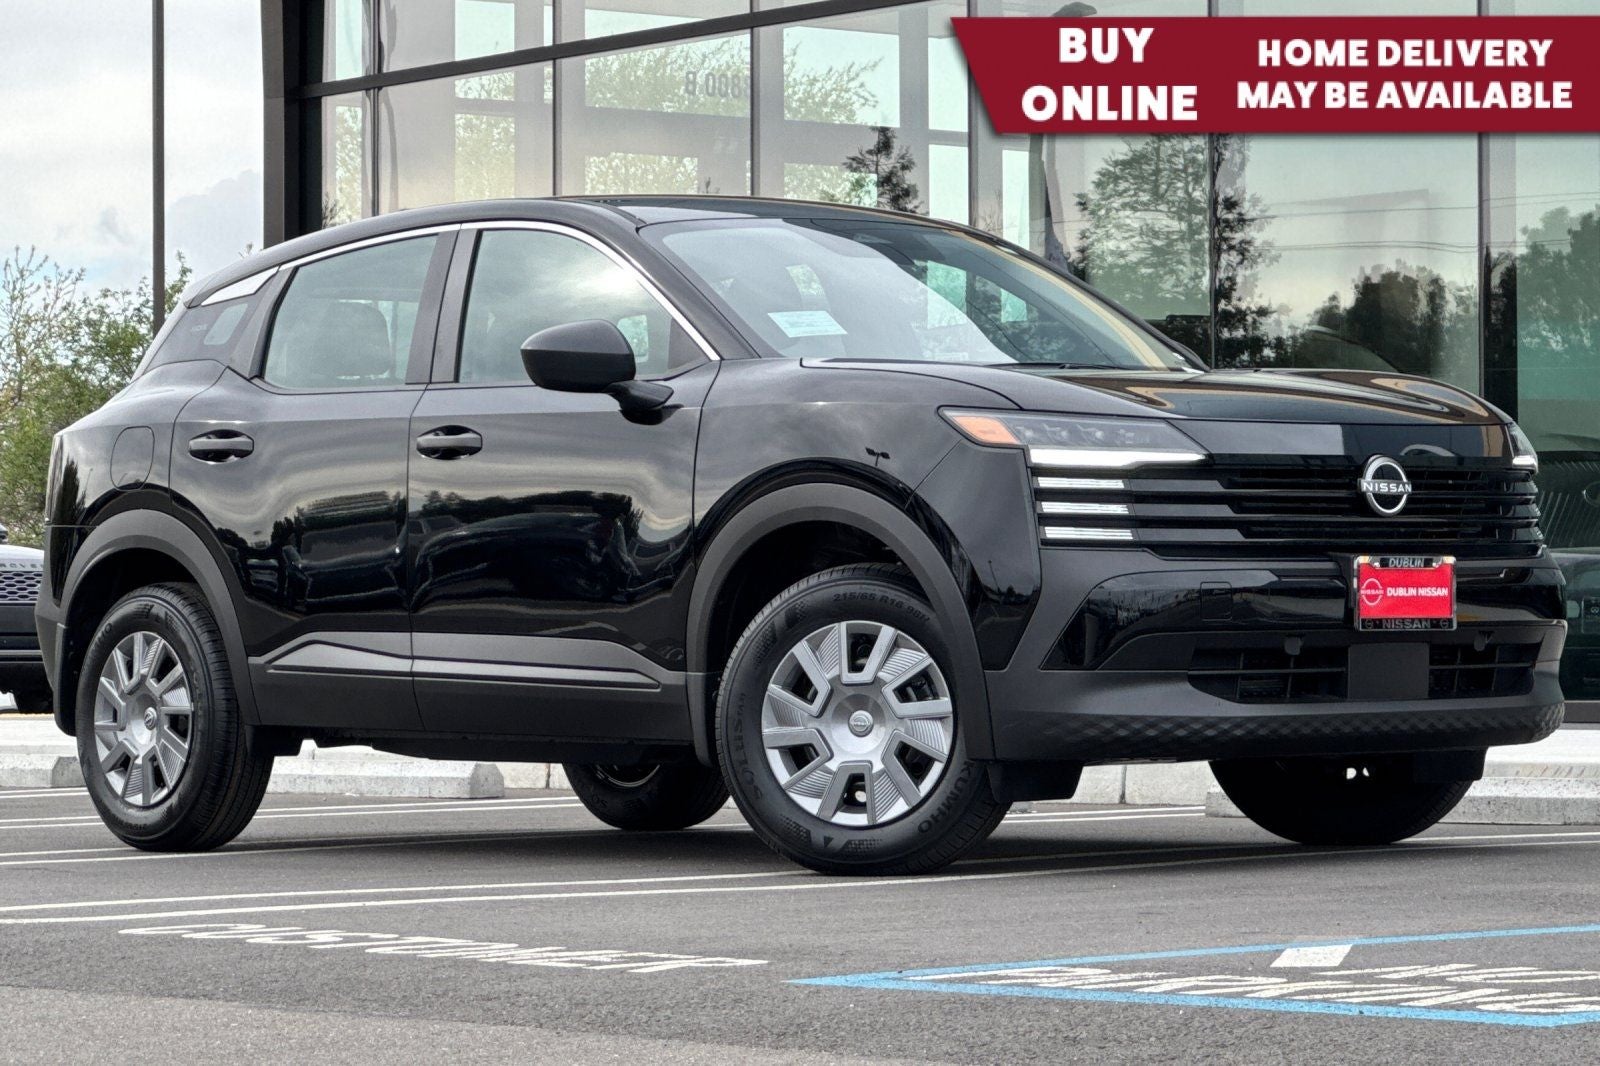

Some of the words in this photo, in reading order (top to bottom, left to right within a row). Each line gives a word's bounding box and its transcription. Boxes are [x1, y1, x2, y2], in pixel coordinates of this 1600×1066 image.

[1363, 482, 1412, 493] NISSAN
[1388, 557, 1425, 568] DUBLIN
[1386, 587, 1417, 597] DUBLIN
[1418, 587, 1449, 597] NISSAN
[1382, 619, 1431, 629] NISSAN
[917, 761, 976, 834] KUMHO
[118, 923, 768, 973] CUSTOMER
[1312, 963, 1600, 983] NO
[909, 965, 1600, 1012] PARKING
